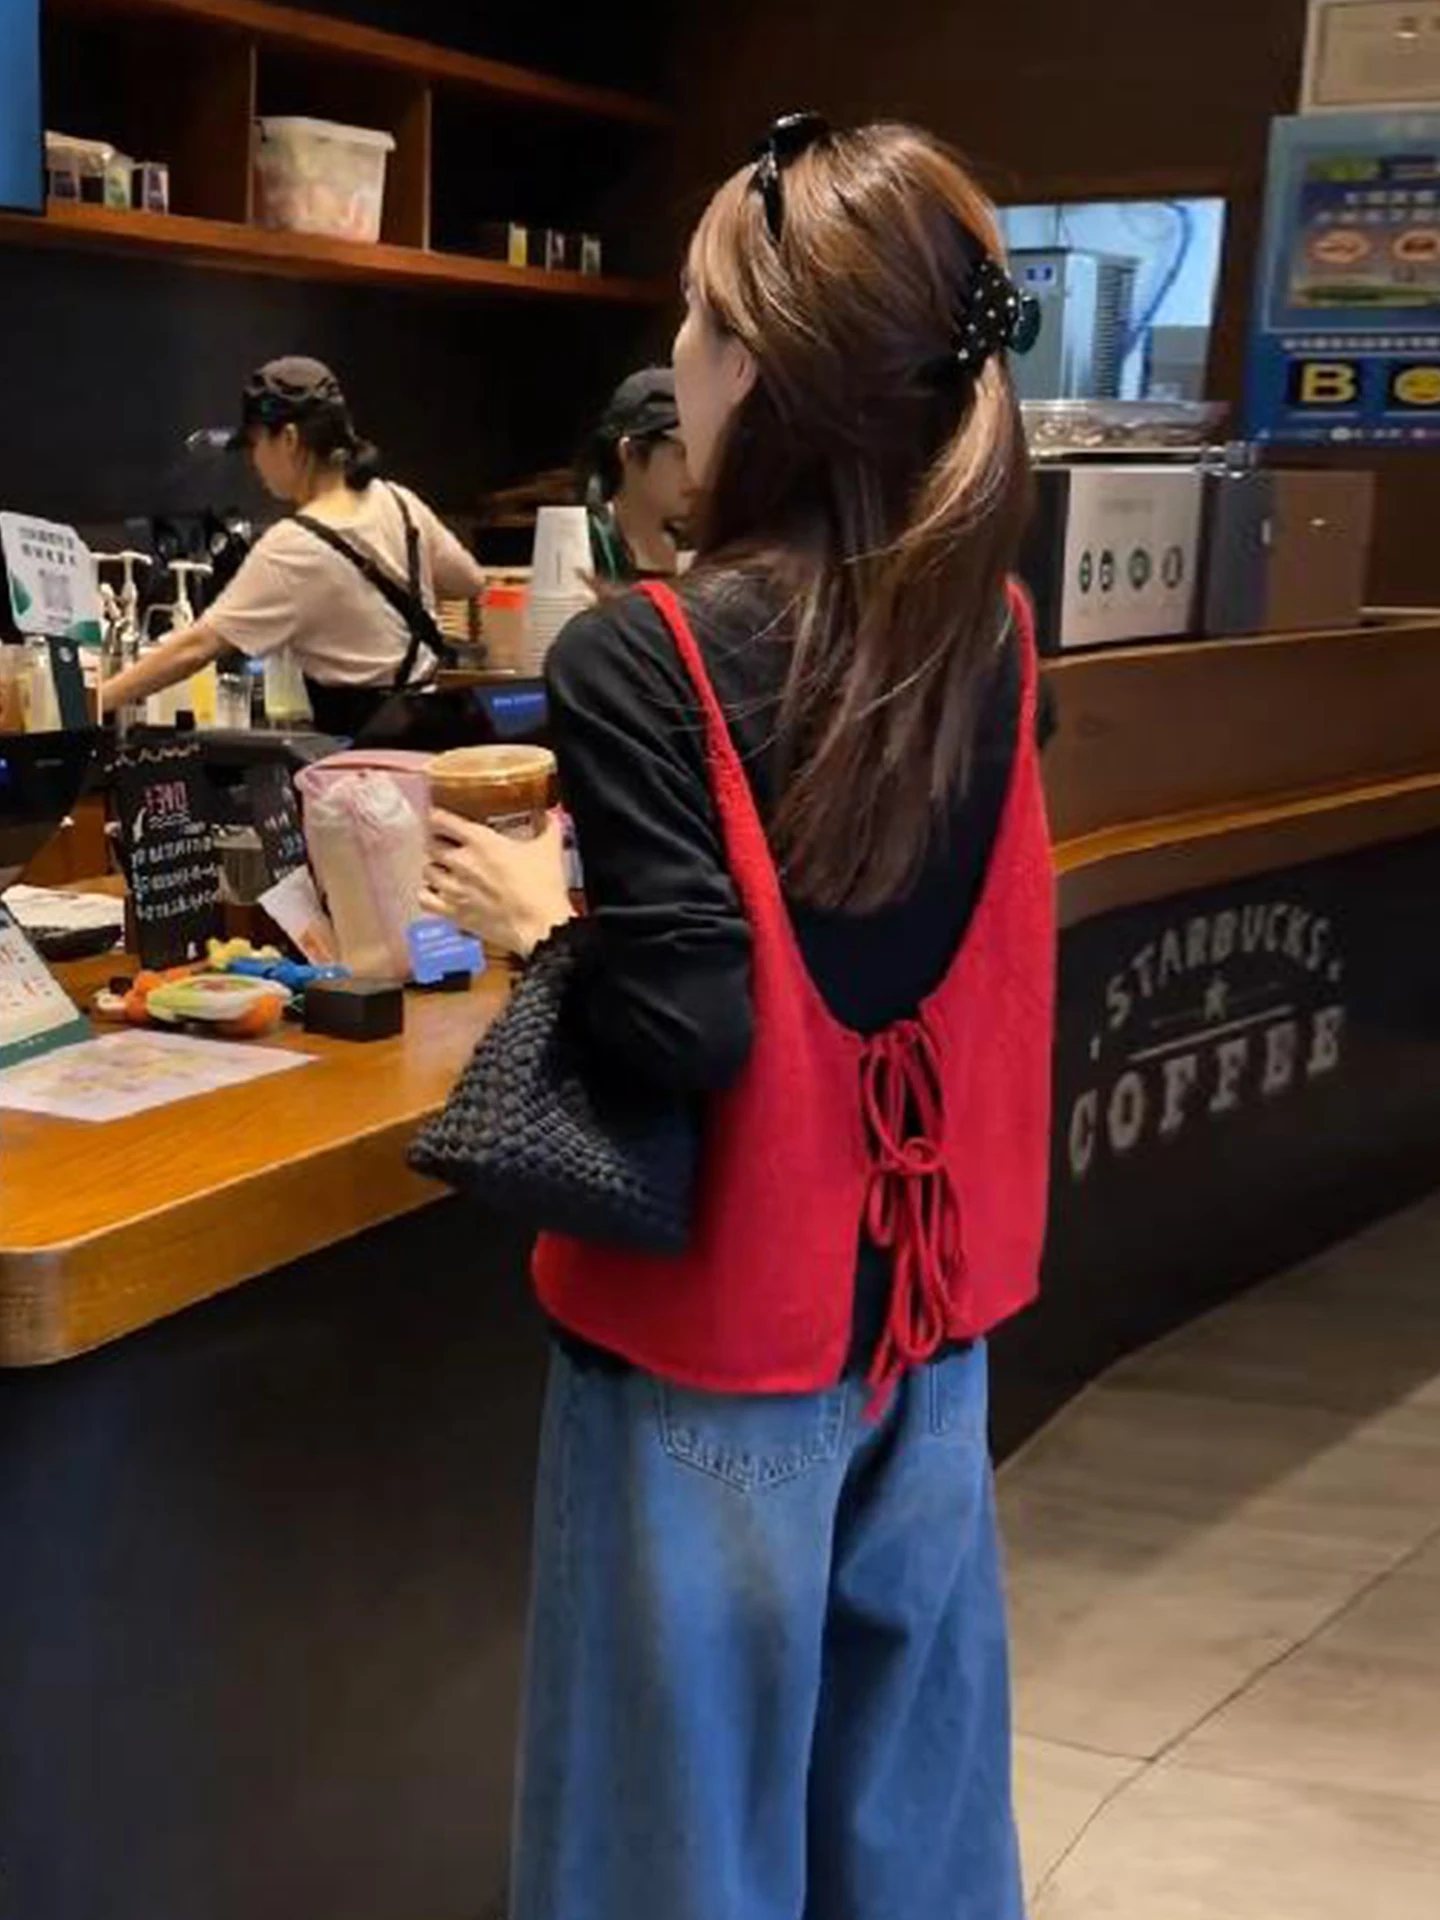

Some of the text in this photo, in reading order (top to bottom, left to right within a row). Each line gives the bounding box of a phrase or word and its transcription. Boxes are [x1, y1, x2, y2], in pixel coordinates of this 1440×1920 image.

[1301, 362, 1357, 402] B
[1105, 904, 1330, 1029] STARBUCKS
[1069, 1004, 1345, 1174] COFFEE
